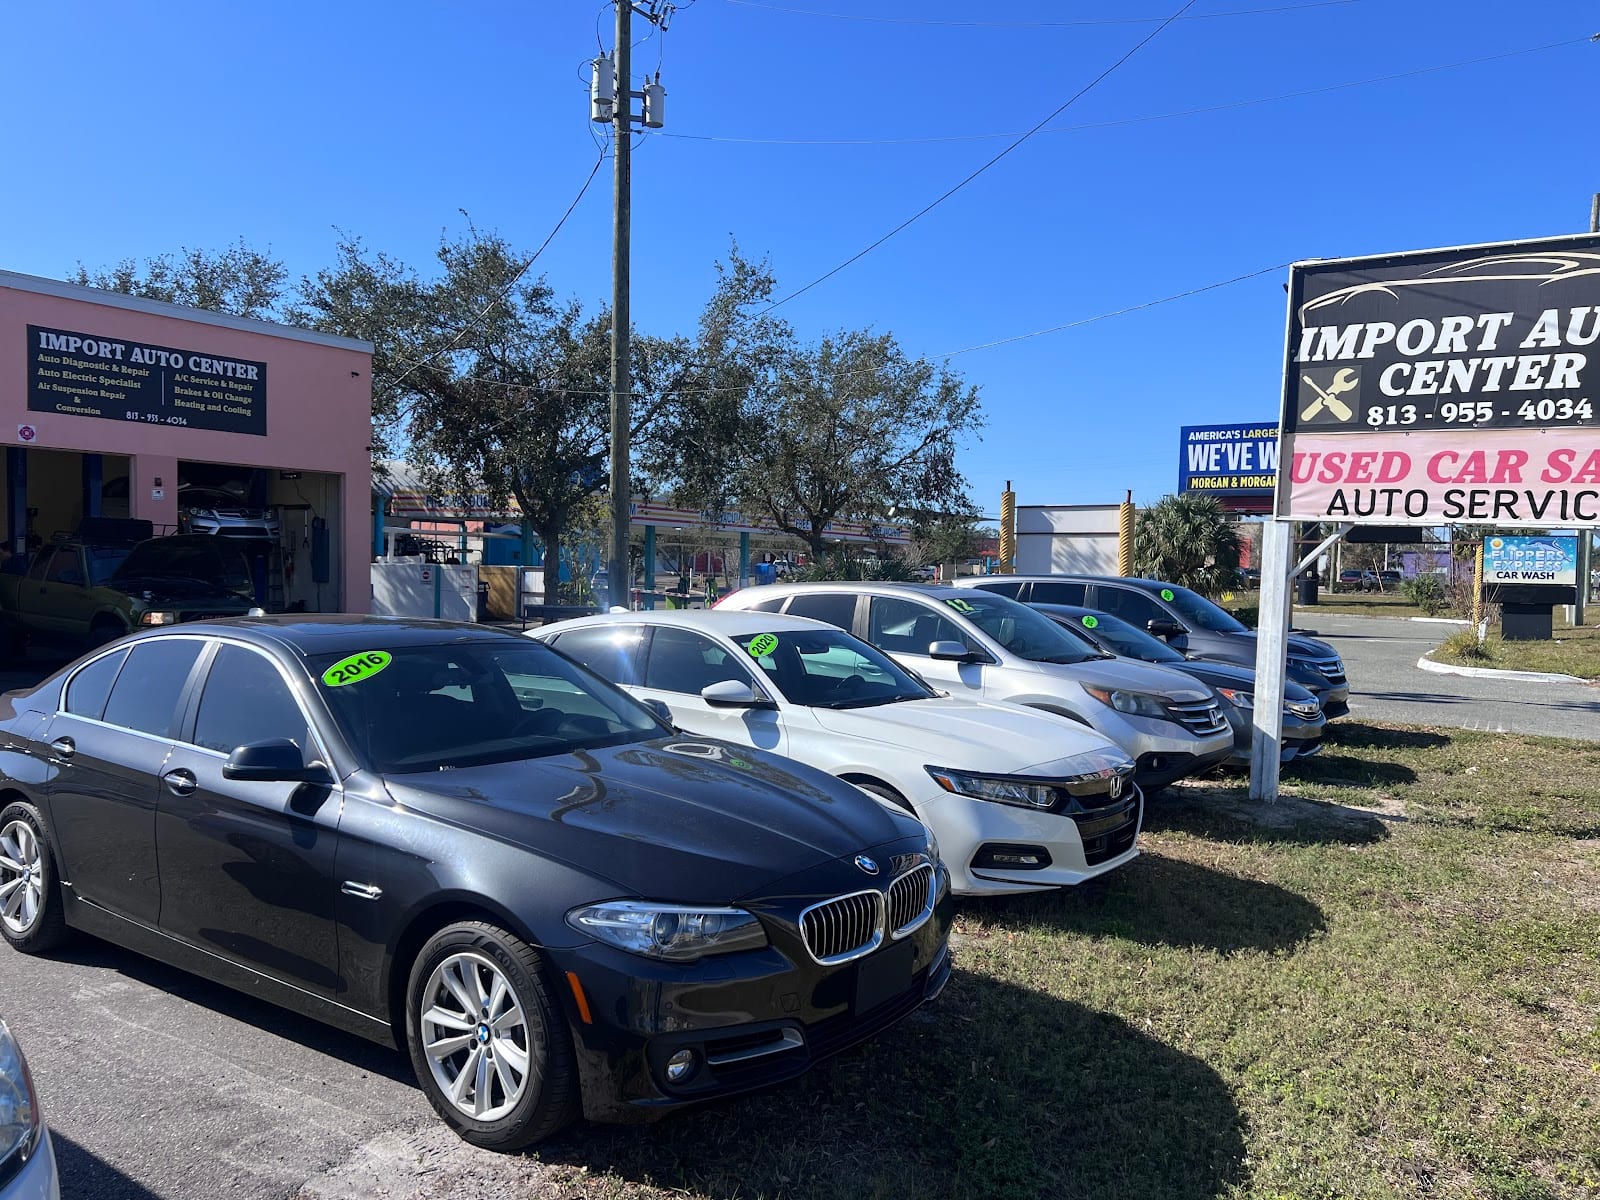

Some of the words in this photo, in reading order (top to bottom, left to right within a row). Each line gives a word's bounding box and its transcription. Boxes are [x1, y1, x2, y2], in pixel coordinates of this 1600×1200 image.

[1293, 312, 1514, 362] IMPORT
[1519, 306, 1600, 349] AU
[37, 353, 60, 364] Auto
[62, 356, 110, 370] Diagnostic
[112, 364, 120, 373] &
[121, 365, 150, 376] Repair
[38, 331, 125, 360] IMPORT
[130, 347, 184, 369] AUTO
[188, 356, 259, 380] CENTER
[37, 367, 60, 378] Auto
[62, 370, 97, 382] Electric
[99, 376, 141, 389] Specialist
[174, 373, 189, 382] A/C
[190, 375, 219, 386] Service
[220, 380, 228, 388] &
[229, 380, 254, 391] Repair
[1379, 353, 1587, 397] CENTER
[37, 382, 50, 390] Air
[52, 384, 98, 396] Suspension
[100, 389, 126, 400] Repair
[73, 396, 81, 404] &
[174, 386, 202, 397] Brakes
[203, 390, 210, 398] &
[211, 391, 223, 400] Oil
[224, 393, 253, 404] Change
[56, 403, 101, 415] Conversion
[174, 399, 206, 411] Heating
[206, 403, 222, 412] and
[223, 405, 252, 417] Cooling
[1366, 405, 1417, 426] 813
[1440, 402, 1494, 423] 955
[1517, 398, 1593, 421] 4034
[126, 410, 139, 420] 813
[146, 413, 159, 423] 955
[166, 416, 187, 425] 4034
[1188, 430, 1241, 441] AMERICA'S
[1187, 442, 1253, 471] WE'VE
[1289, 451, 1412, 484] USED
[1426, 450, 1529, 484] CAR
[1541, 448, 1600, 484] SA
[1191, 477, 1229, 489] MORGAN
[1231, 476, 1238, 488] &
[1326, 488, 1429, 517] AUTO
[1443, 489, 1600, 520] SERVIC
[1491, 550, 1565, 561] FLIPPERS
[1493, 560, 1563, 572] EXPRESS
[1496, 571, 1518, 579] CAR
[1521, 571, 1555, 580] WASH
[751, 634, 775, 655] 2020
[331, 653, 383, 683] 2016
